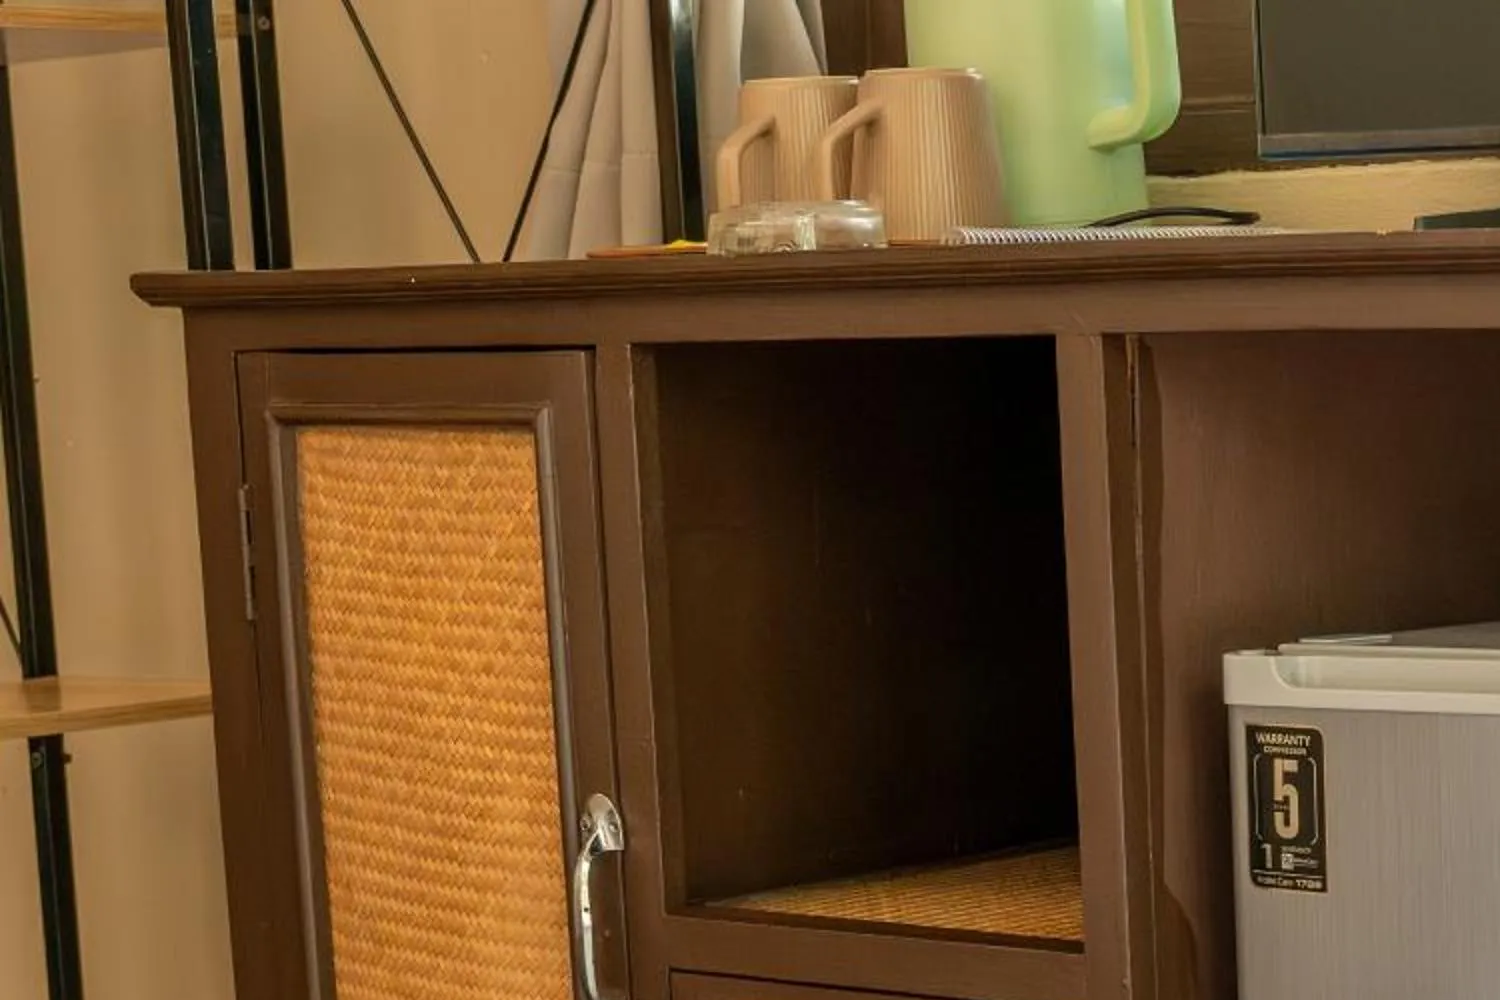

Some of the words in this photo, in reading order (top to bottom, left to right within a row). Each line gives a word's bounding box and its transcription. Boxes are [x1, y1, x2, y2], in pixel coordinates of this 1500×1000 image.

[1256, 732, 1311, 747] WARRANTY
[1274, 758, 1299, 839] 5
[1261, 843, 1273, 869] 1
